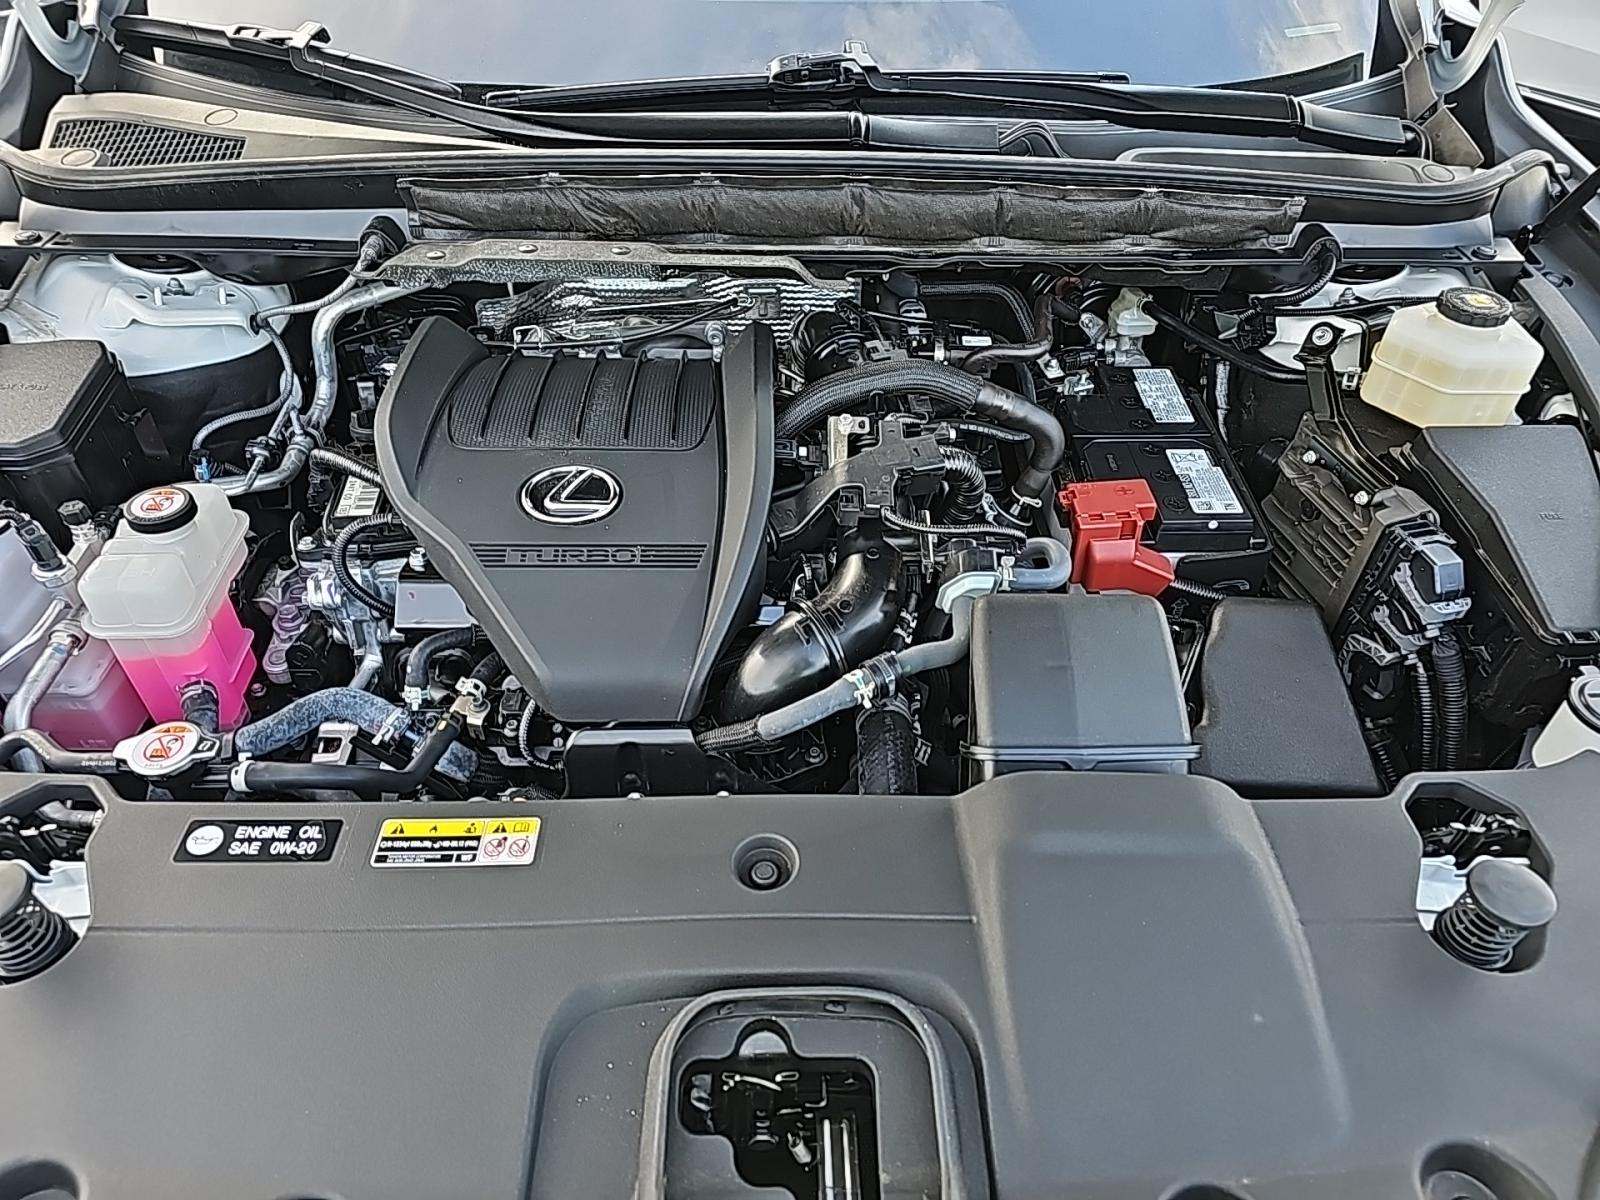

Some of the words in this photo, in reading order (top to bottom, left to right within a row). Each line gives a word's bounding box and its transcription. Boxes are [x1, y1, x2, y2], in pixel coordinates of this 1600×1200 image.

[505, 548, 640, 564] TURBO
[234, 825, 292, 839] ENGINE
[299, 825, 323, 839] OIL
[228, 841, 262, 855] SAE
[269, 841, 318, 855] 0W-20
